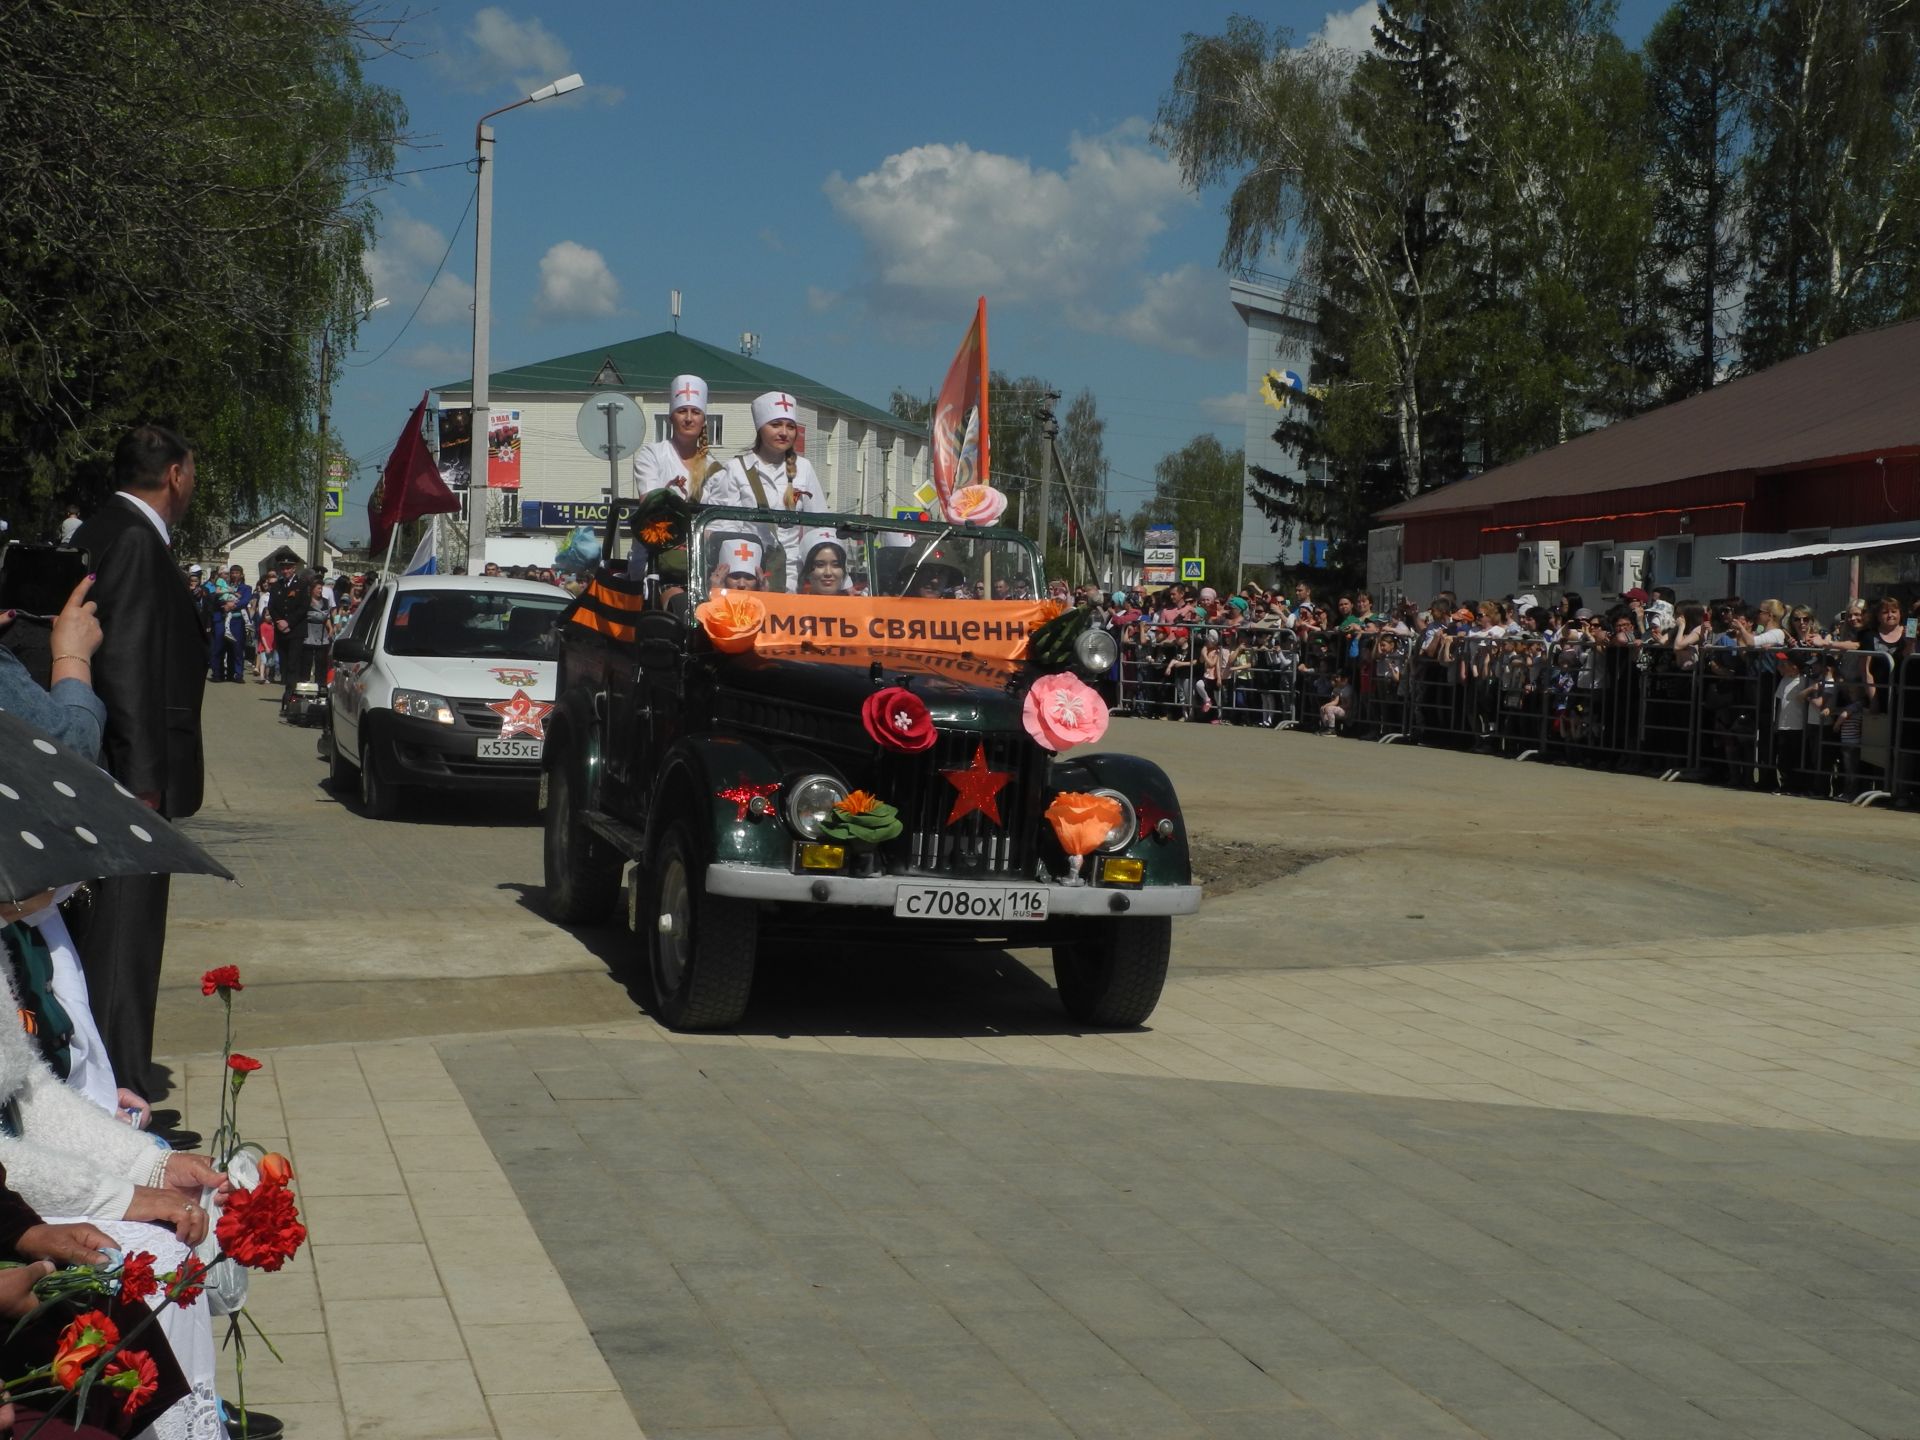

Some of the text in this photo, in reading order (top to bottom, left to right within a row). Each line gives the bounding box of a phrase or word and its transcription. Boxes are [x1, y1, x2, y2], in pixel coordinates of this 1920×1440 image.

[574, 505, 630, 520] НАСО
[869, 616, 1031, 645] священн
[1007, 891, 1042, 911] 116
[1012, 910, 1031, 918] RUS
